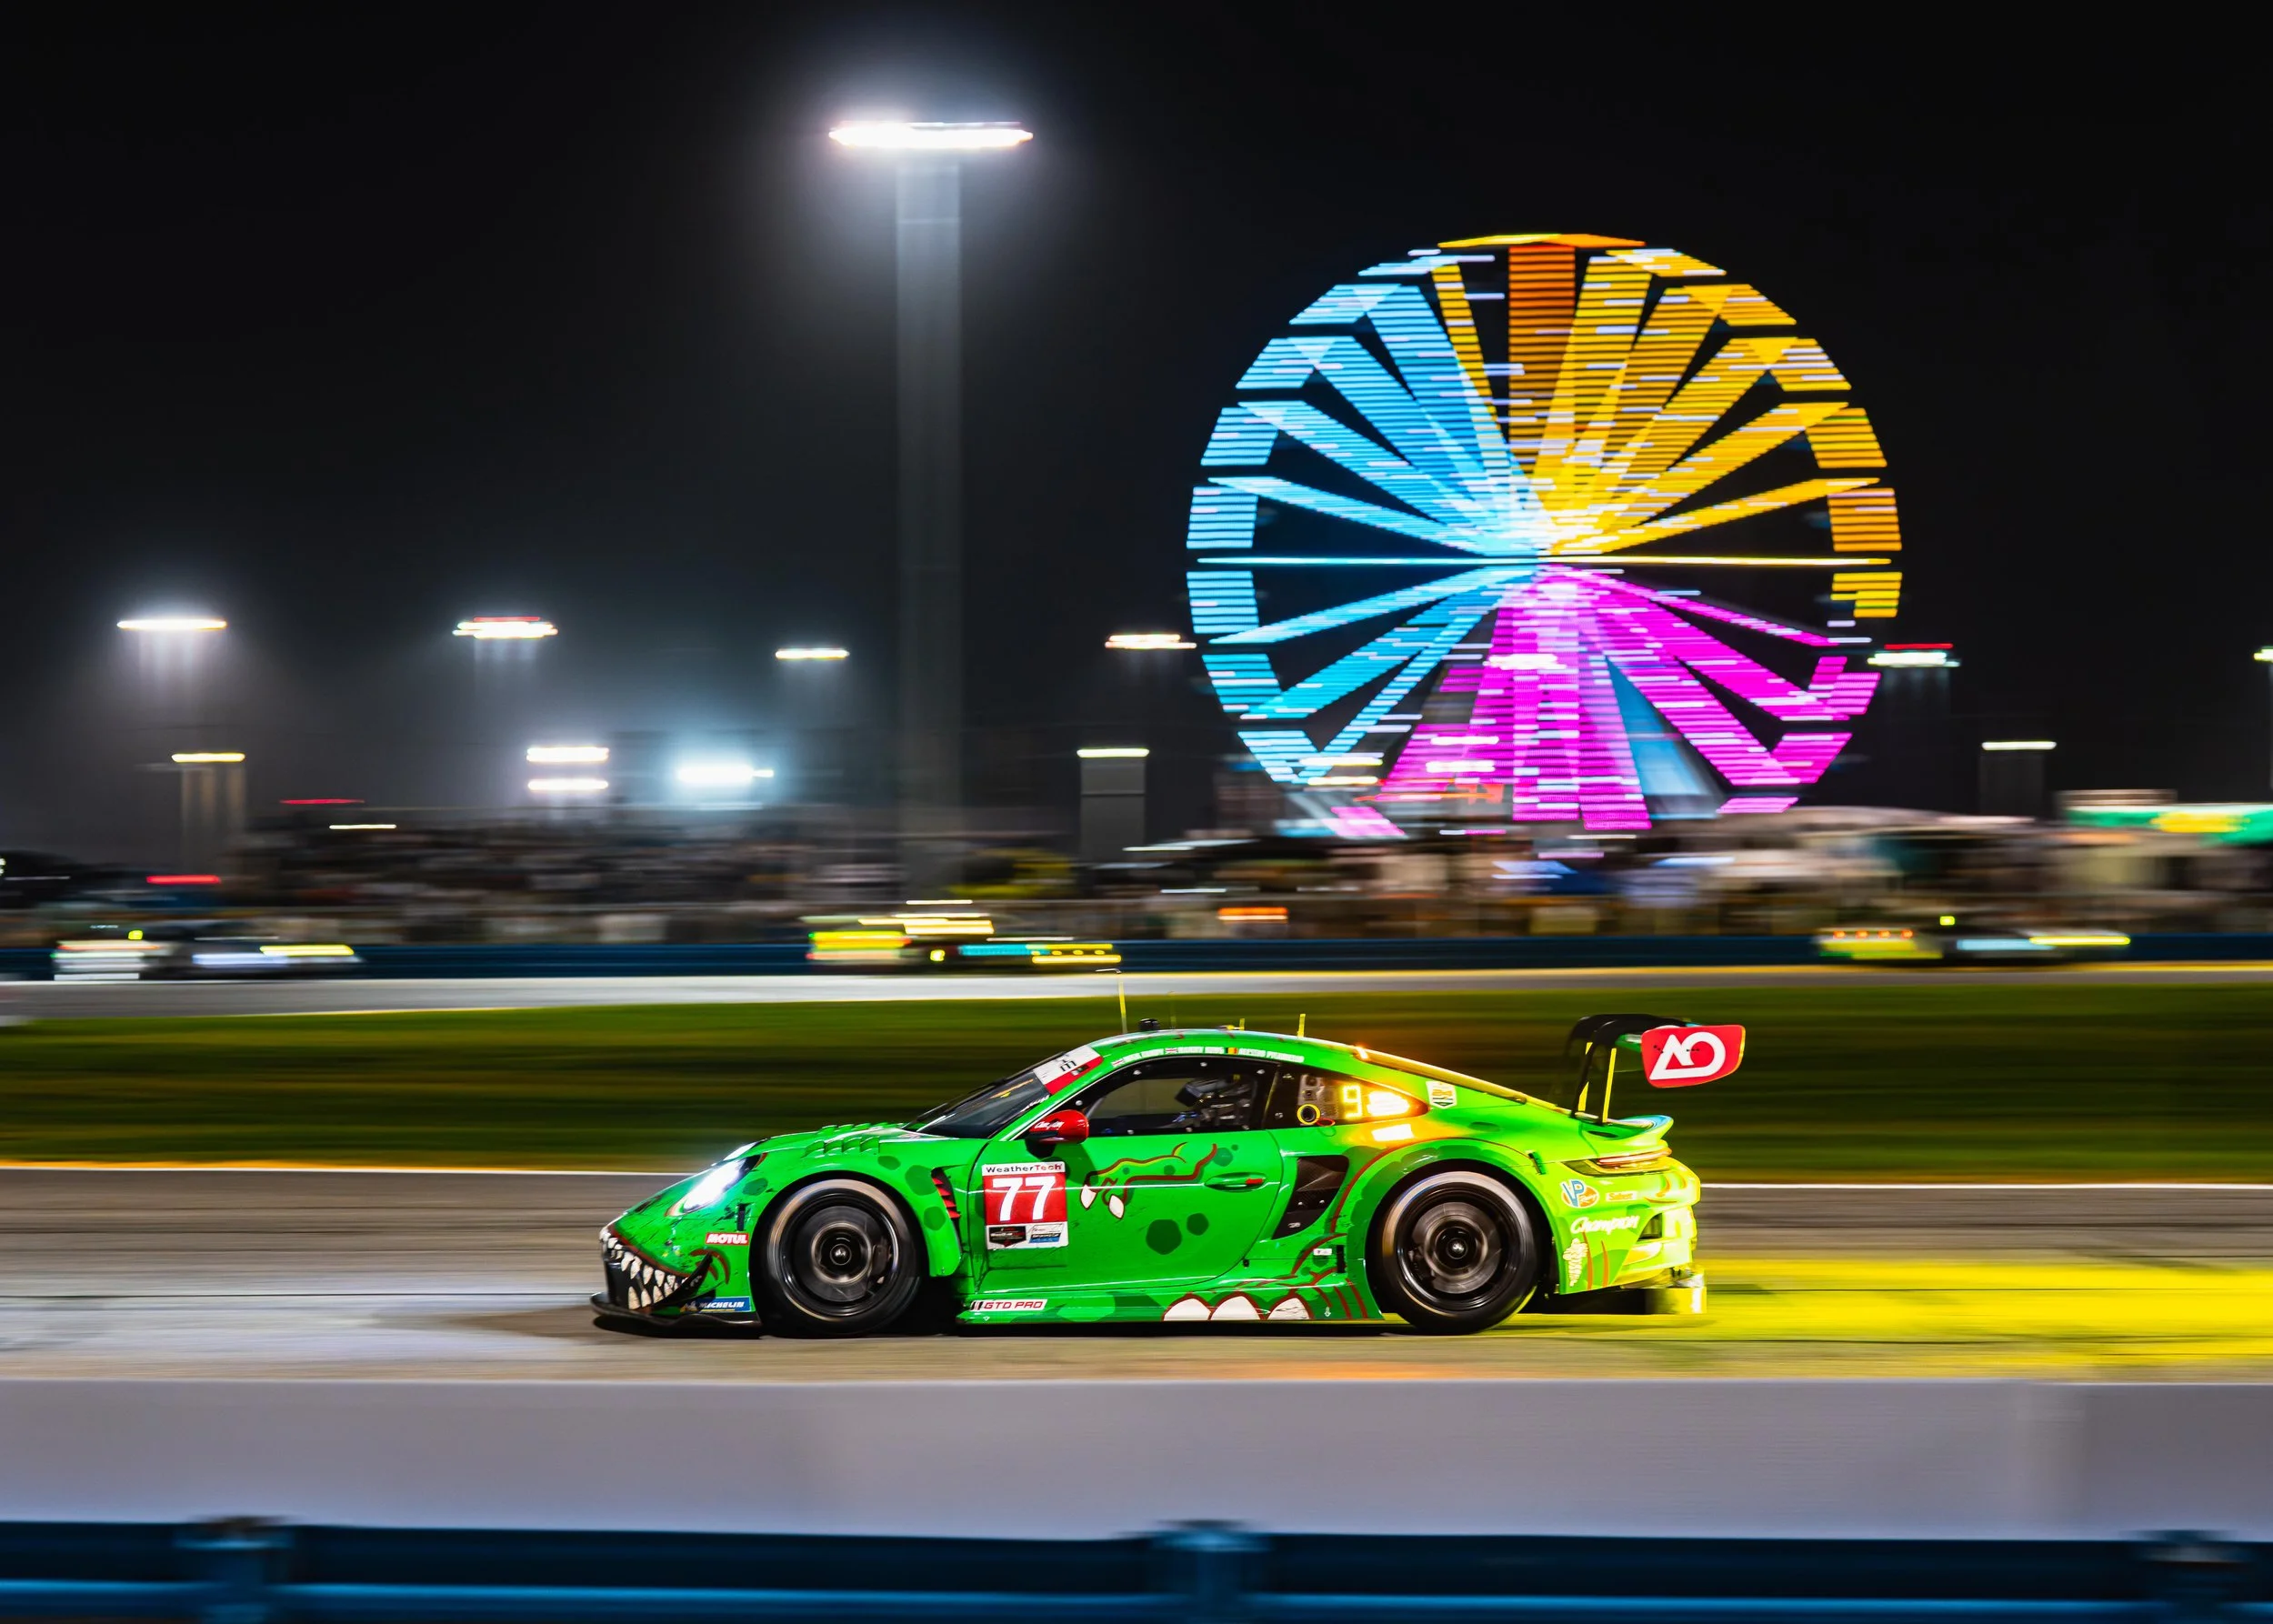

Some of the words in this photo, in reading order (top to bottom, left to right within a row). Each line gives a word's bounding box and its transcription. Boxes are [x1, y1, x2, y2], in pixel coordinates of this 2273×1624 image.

[1341, 1084, 1364, 1119] 9
[986, 1164, 1062, 1173] WeatherTech
[992, 1176, 1056, 1221] 77
[1562, 1179, 1585, 1208] VP
[706, 1233, 748, 1244] MOTUL
